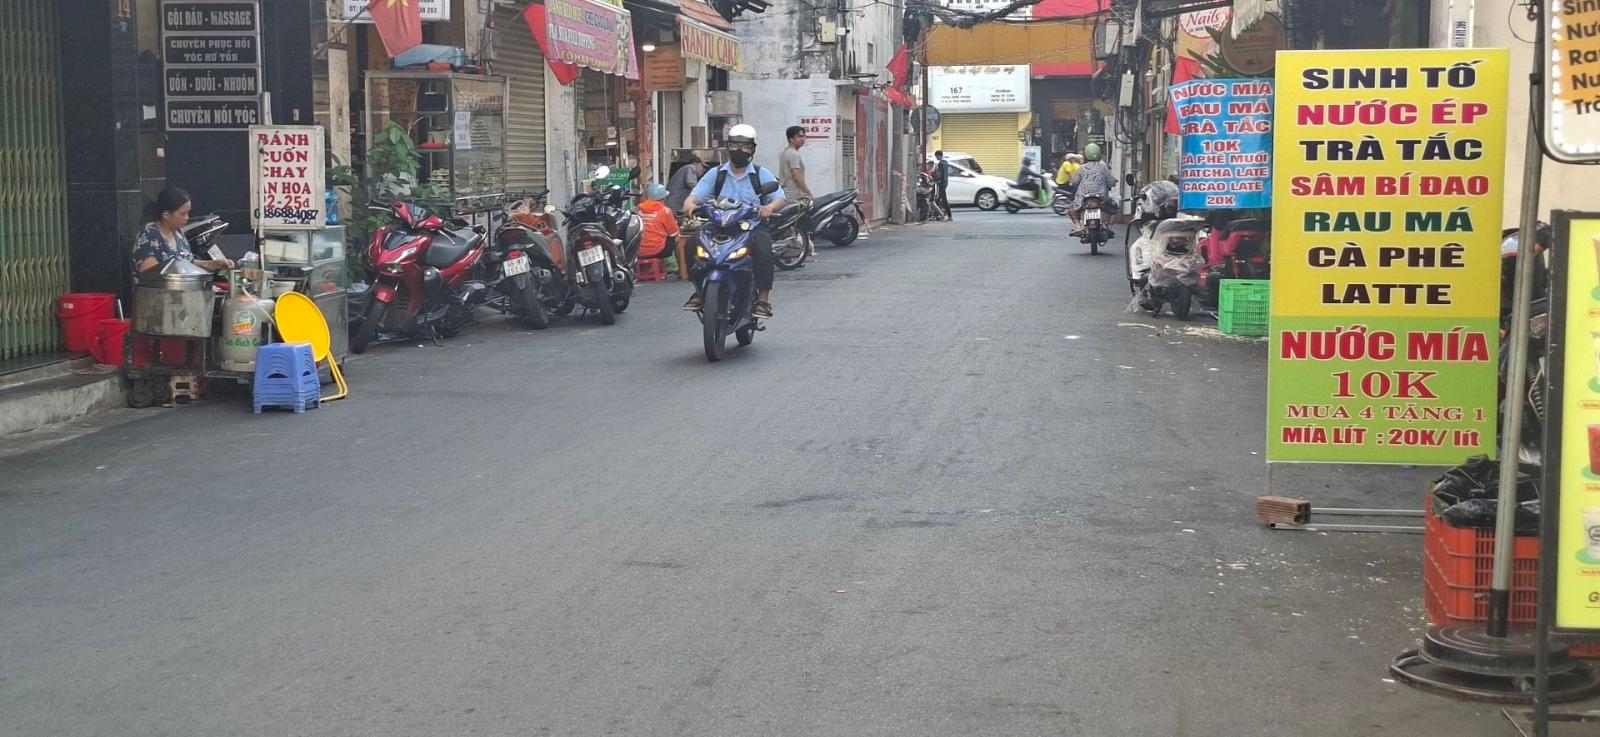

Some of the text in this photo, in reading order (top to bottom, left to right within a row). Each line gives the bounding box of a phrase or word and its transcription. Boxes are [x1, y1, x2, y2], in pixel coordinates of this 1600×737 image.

[210, 10, 252, 26] MASSAGE
[1186, 9, 1220, 27] Nails
[170, 38, 206, 49] CHUYÊN
[1302, 60, 1483, 90] SINH TỐ
[950, 86, 963, 94] 167
[1173, 81, 1272, 100] NƯỚC MÍA
[170, 103, 256, 124] CHUYÊN NỐI TÓC
[1179, 99, 1270, 117] RAU MÁ
[1297, 98, 1488, 126] NƯỚC ÉP
[1223, 117, 1270, 133] TẮC
[257, 130, 310, 146] BÁNH
[1201, 140, 1240, 152] 10K
[1299, 132, 1483, 161] TRÀ TẮC
[1197, 153, 1225, 164] PHÊ
[1229, 151, 1268, 163] MUỐI
[1236, 167, 1268, 177] LATE
[281, 181, 311, 194] HOA
[1183, 181, 1262, 191] CACAO LATE
[1291, 172, 1490, 196] SÂM BÍ ĐAO
[1207, 196, 1234, 205] 20K
[1303, 206, 1474, 232] RAU MÁ
[1307, 242, 1465, 268] CÀ PHÊ
[1321, 283, 1452, 304] LATTE
[1280, 325, 1490, 361] NƯỚC MÍA
[1331, 371, 1438, 399] 10K
[1286, 403, 1486, 423] MUA 4 TẶNG 1
[1282, 424, 1328, 444] MÍA
[1331, 424, 1367, 444] LÍT
[1453, 428, 1480, 446] lít
